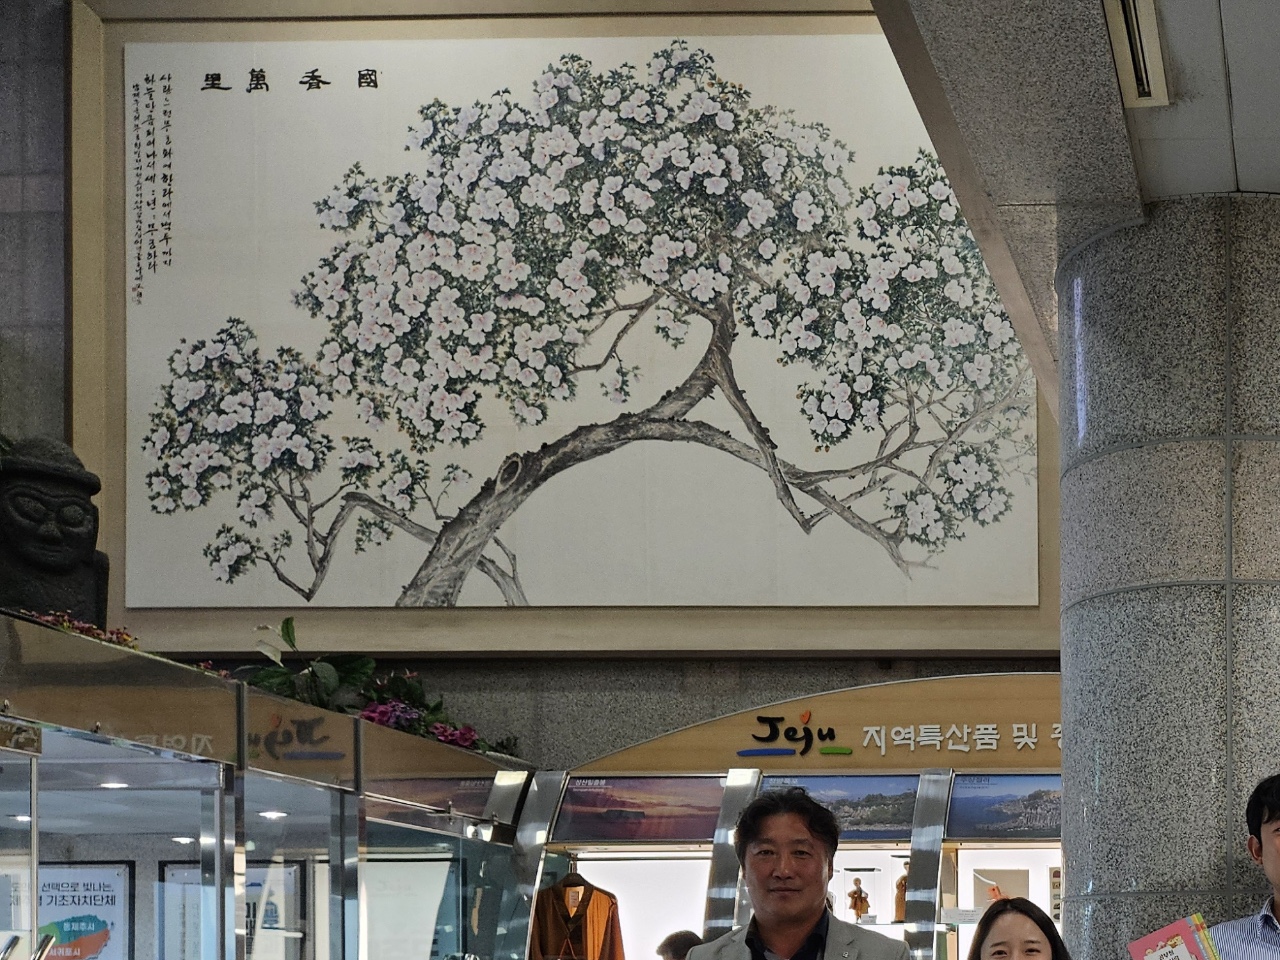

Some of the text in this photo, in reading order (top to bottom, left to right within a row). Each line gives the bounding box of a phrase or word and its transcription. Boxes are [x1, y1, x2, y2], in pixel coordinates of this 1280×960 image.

[751, 711, 836, 755] Jeju
[862, 723, 1001, 755] 지역특산품
[1012, 723, 1037, 751] 및
[41, 882, 79, 892] 선택으로
[83, 882, 114, 893] 빛나는,
[48, 894, 116, 907] 기초자치단체
